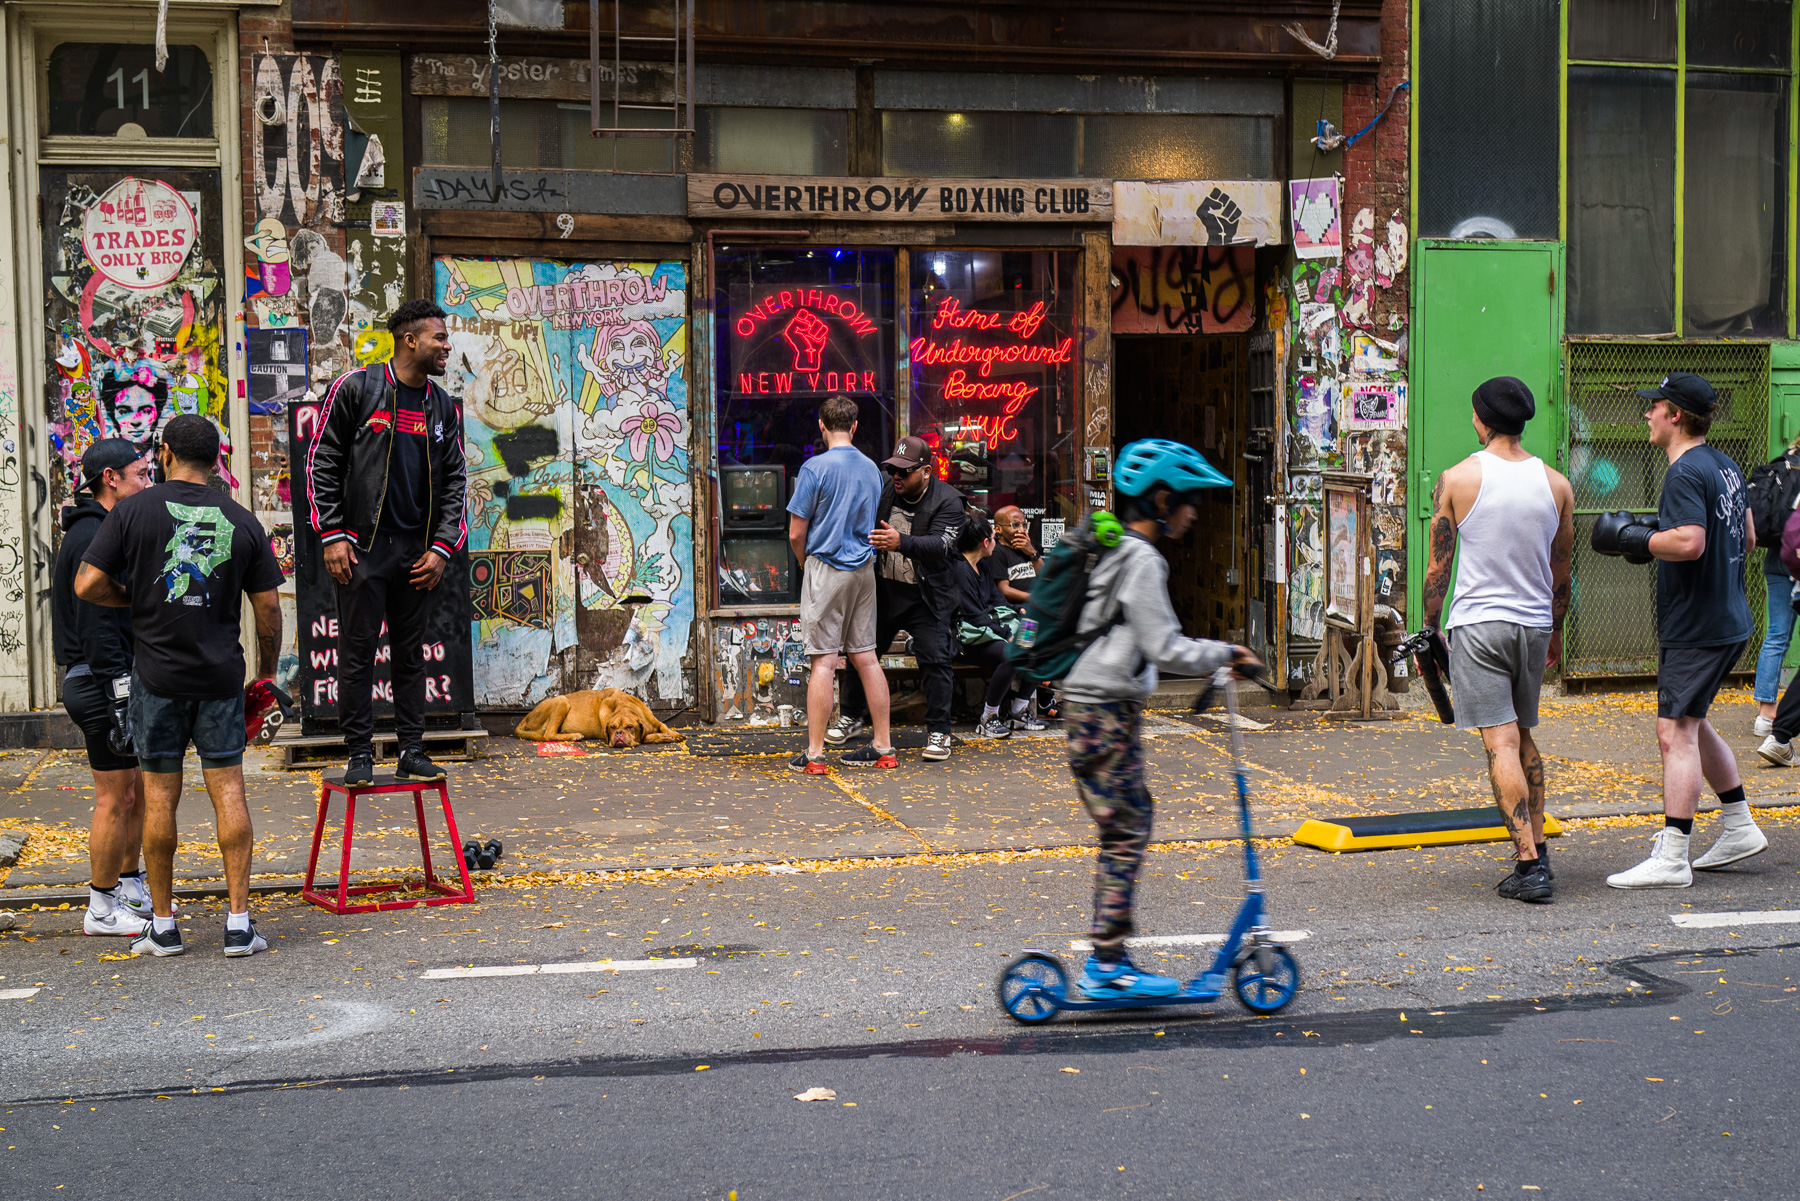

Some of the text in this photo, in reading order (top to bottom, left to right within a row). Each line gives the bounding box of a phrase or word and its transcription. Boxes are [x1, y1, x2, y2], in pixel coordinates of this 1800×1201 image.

[106, 68, 150, 110] 11
[713, 182, 1091, 214] OVERTHROW BOXING CLUB
[92, 228, 186, 250] TRADES
[556, 213, 575, 239] 9
[100, 250, 183, 267] ONLY BRO
[506, 276, 667, 318] OVERTHROW
[450, 314, 539, 343] LIGHT UP!
[552, 309, 623, 331] NEW YORK
[735, 288, 880, 339] OVERTHROW
[932, 296, 1047, 340] Home of
[251, 365, 288, 374] CAUTION
[909, 336, 1073, 377] Underground
[740, 371, 876, 394] NEW YORK
[943, 369, 1039, 415] Boxing
[956, 413, 1019, 451] NYC
[1089, 491, 1106, 499] MIA
